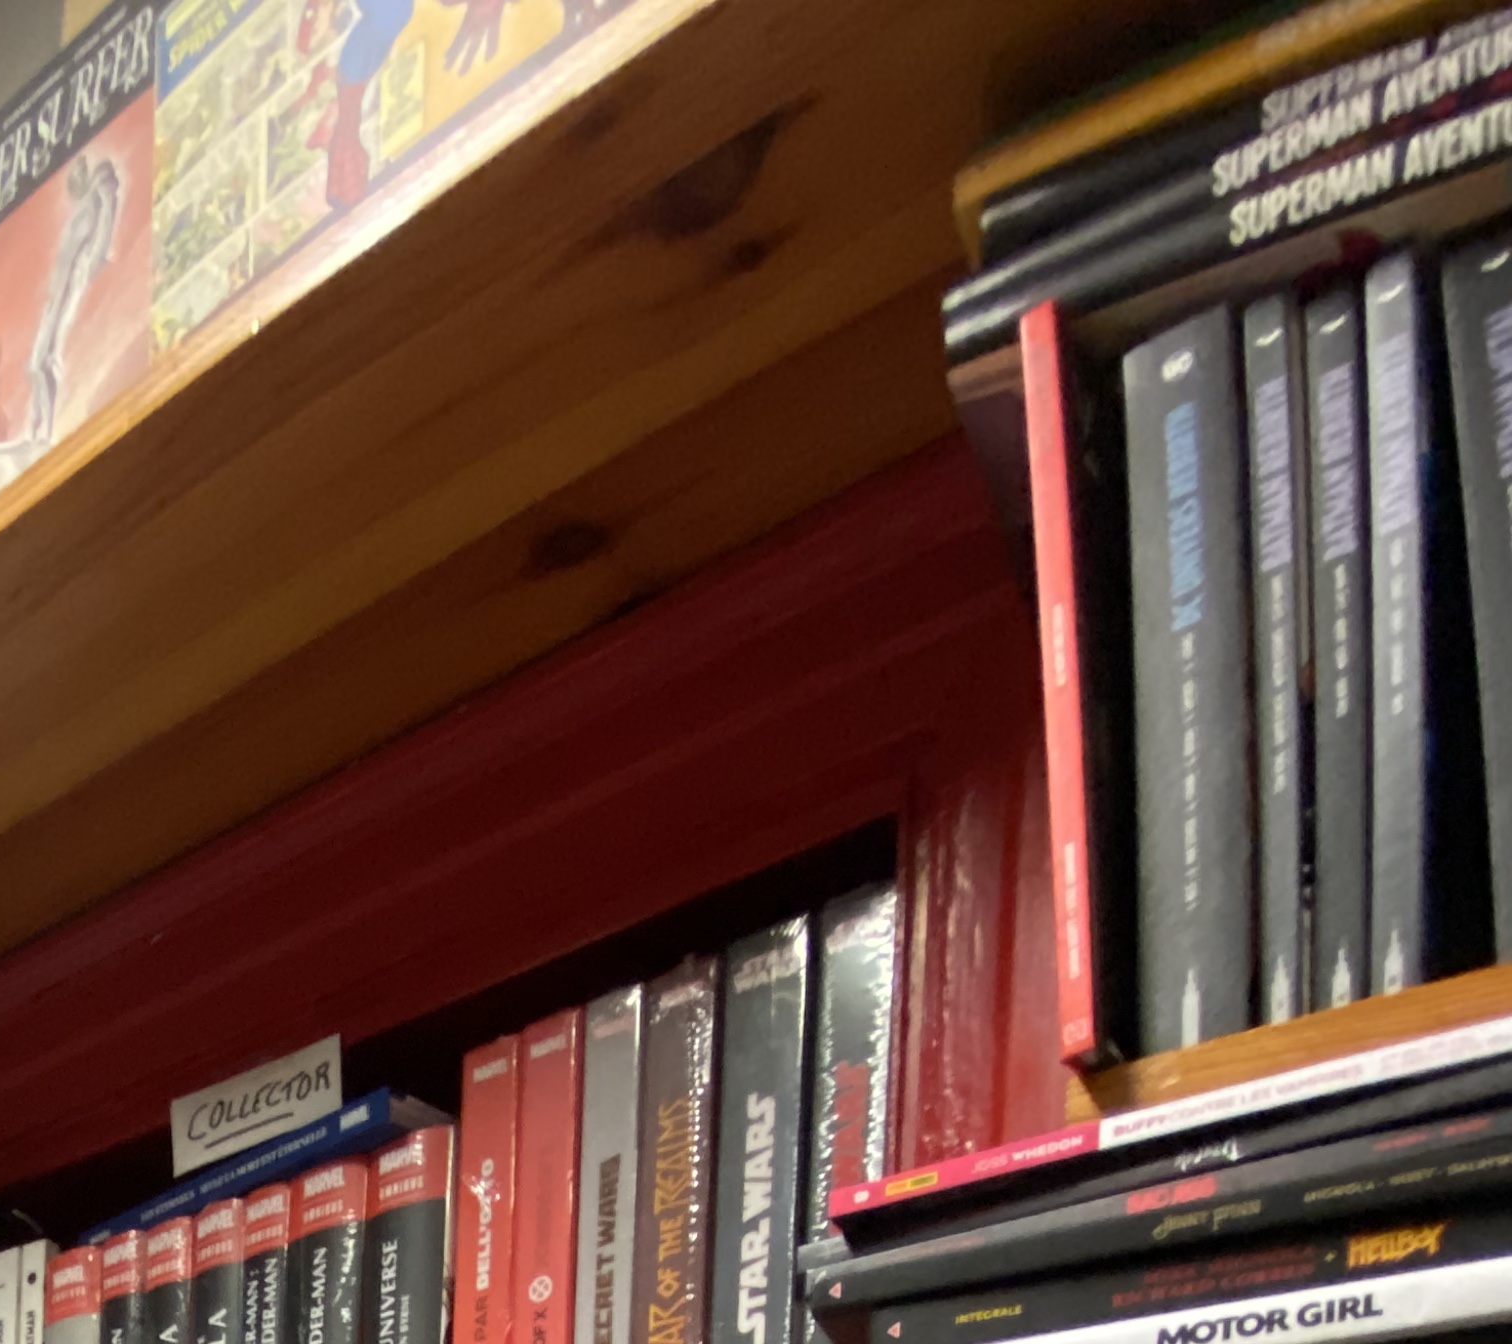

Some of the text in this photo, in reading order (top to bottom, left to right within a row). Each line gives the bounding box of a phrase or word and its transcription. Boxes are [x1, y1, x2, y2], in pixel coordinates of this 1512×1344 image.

[32, 6, 153, 179] SURFER
[1212, 88, 1373, 197] SUPERMAN
[1229, 142, 1394, 247] SUPERMAN
[187, 1060, 330, 1141] COLLECTOR
[1011, 1115, 1167, 1162] WHEDON BUFFY
[596, 1153, 622, 1245] WARS
[742, 1091, 777, 1224] WARS
[1346, 1220, 1449, 1269] HELLBOY
[1298, 1292, 1383, 1328] GIRL
